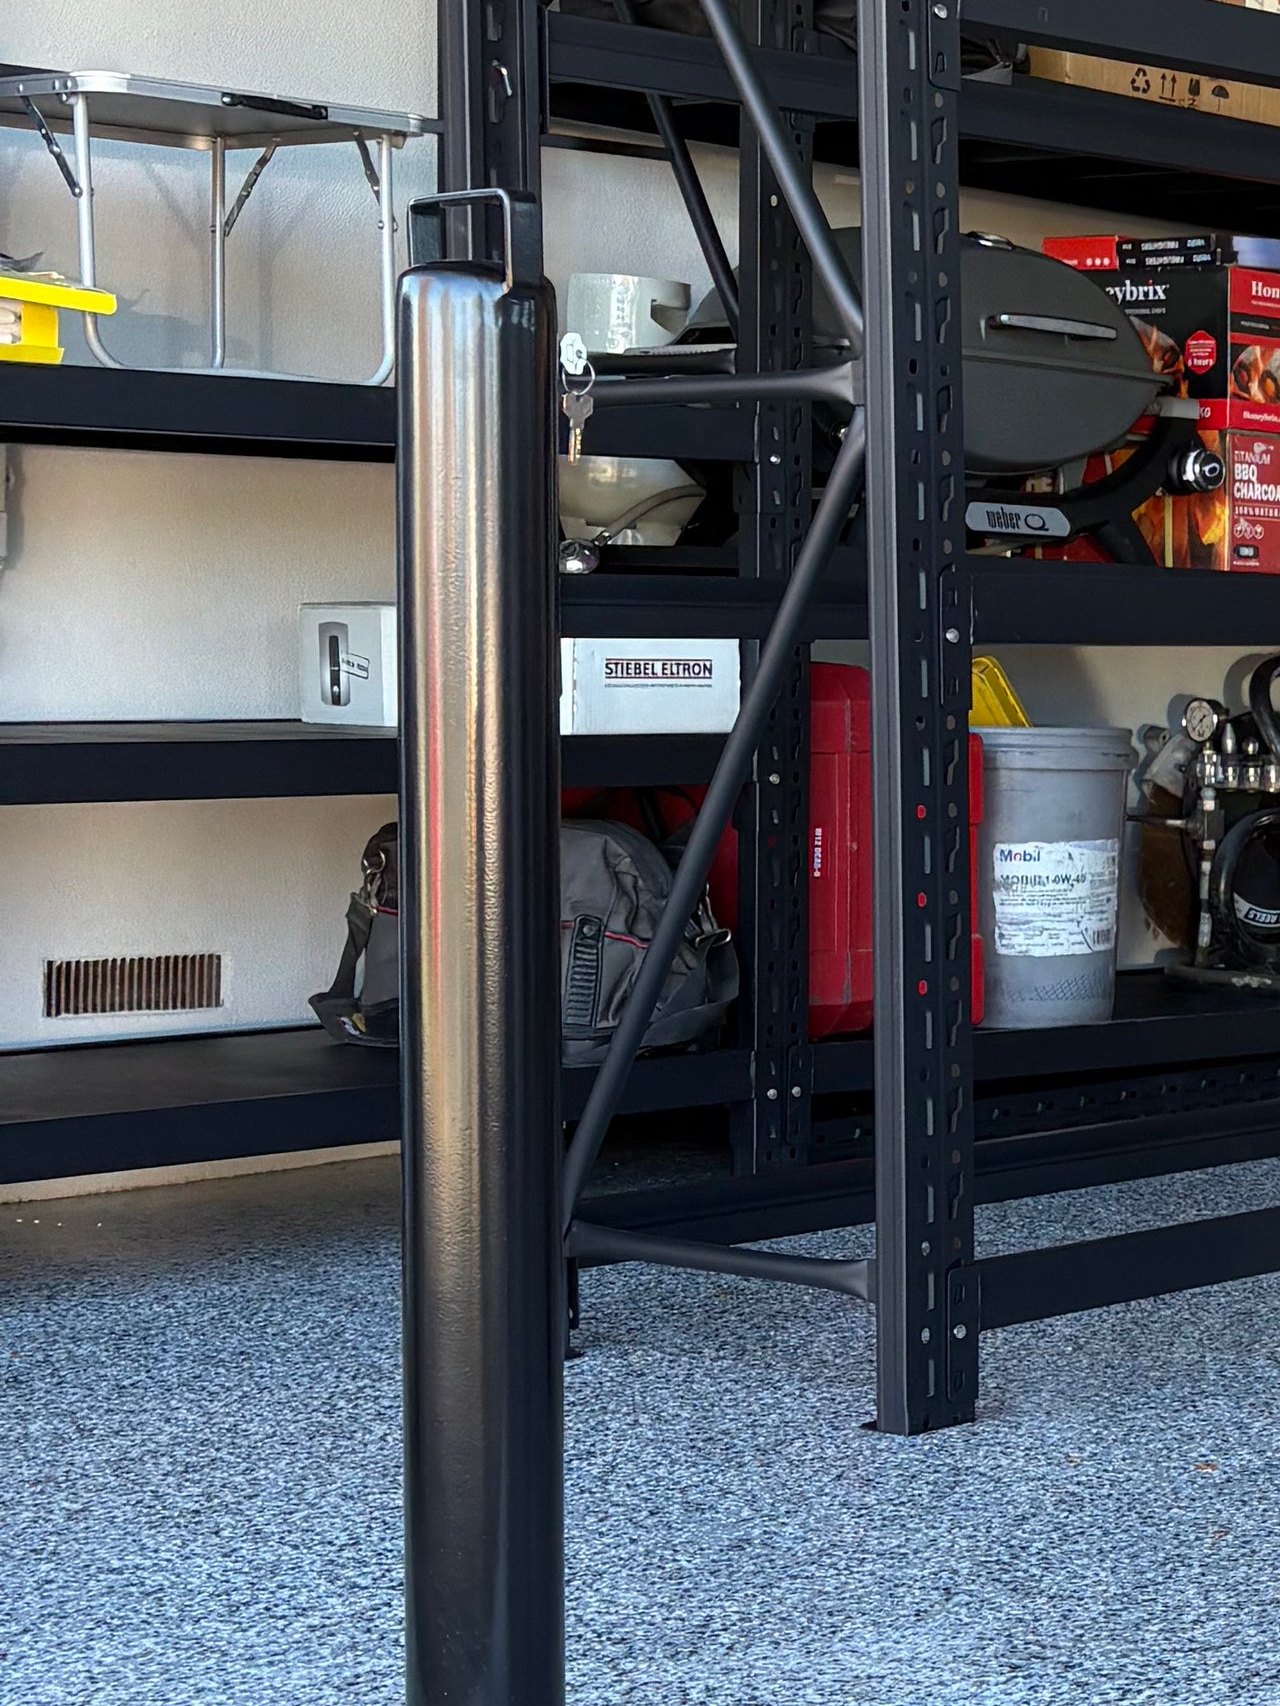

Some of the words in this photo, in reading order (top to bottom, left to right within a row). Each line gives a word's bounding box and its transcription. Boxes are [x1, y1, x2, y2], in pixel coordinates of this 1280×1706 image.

[1234, 463, 1258, 484] BBQ
[985, 506, 1021, 530] weber
[605, 662, 658, 676] STIEBEL
[661, 662, 713, 676] ELTRON
[1000, 848, 1041, 863] Mobil
[1248, 909, 1278, 924] REELS
